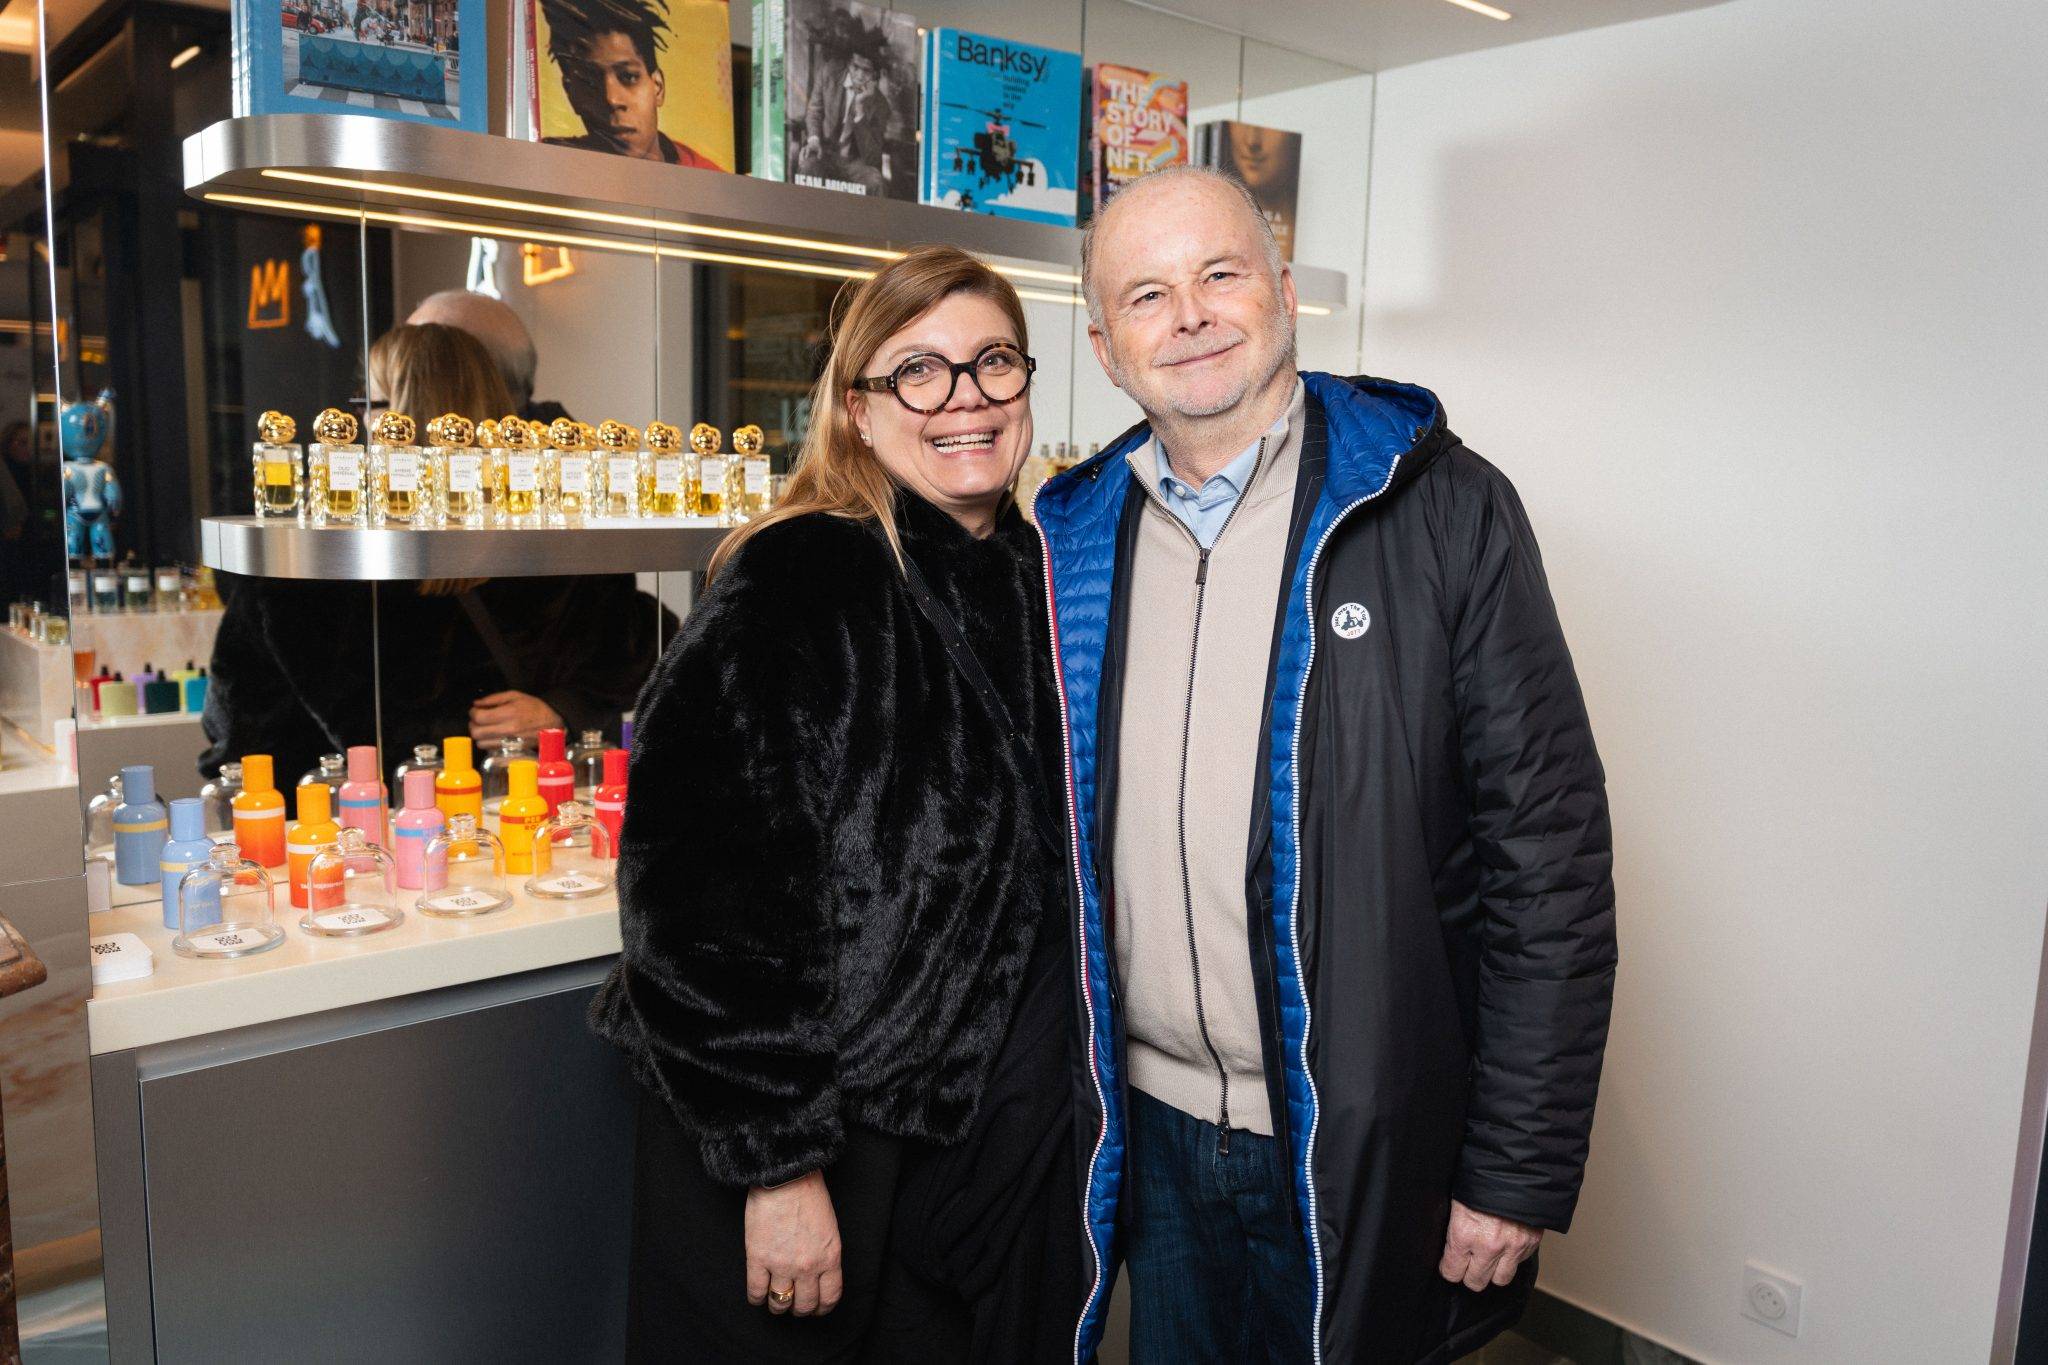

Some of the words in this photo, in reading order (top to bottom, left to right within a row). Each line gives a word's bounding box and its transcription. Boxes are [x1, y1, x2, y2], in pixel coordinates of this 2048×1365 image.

[957, 35, 1047, 82] Banksy
[1107, 79, 1148, 104] THE
[1106, 102, 1174, 133] STORY
[1107, 124, 1135, 146] OF
